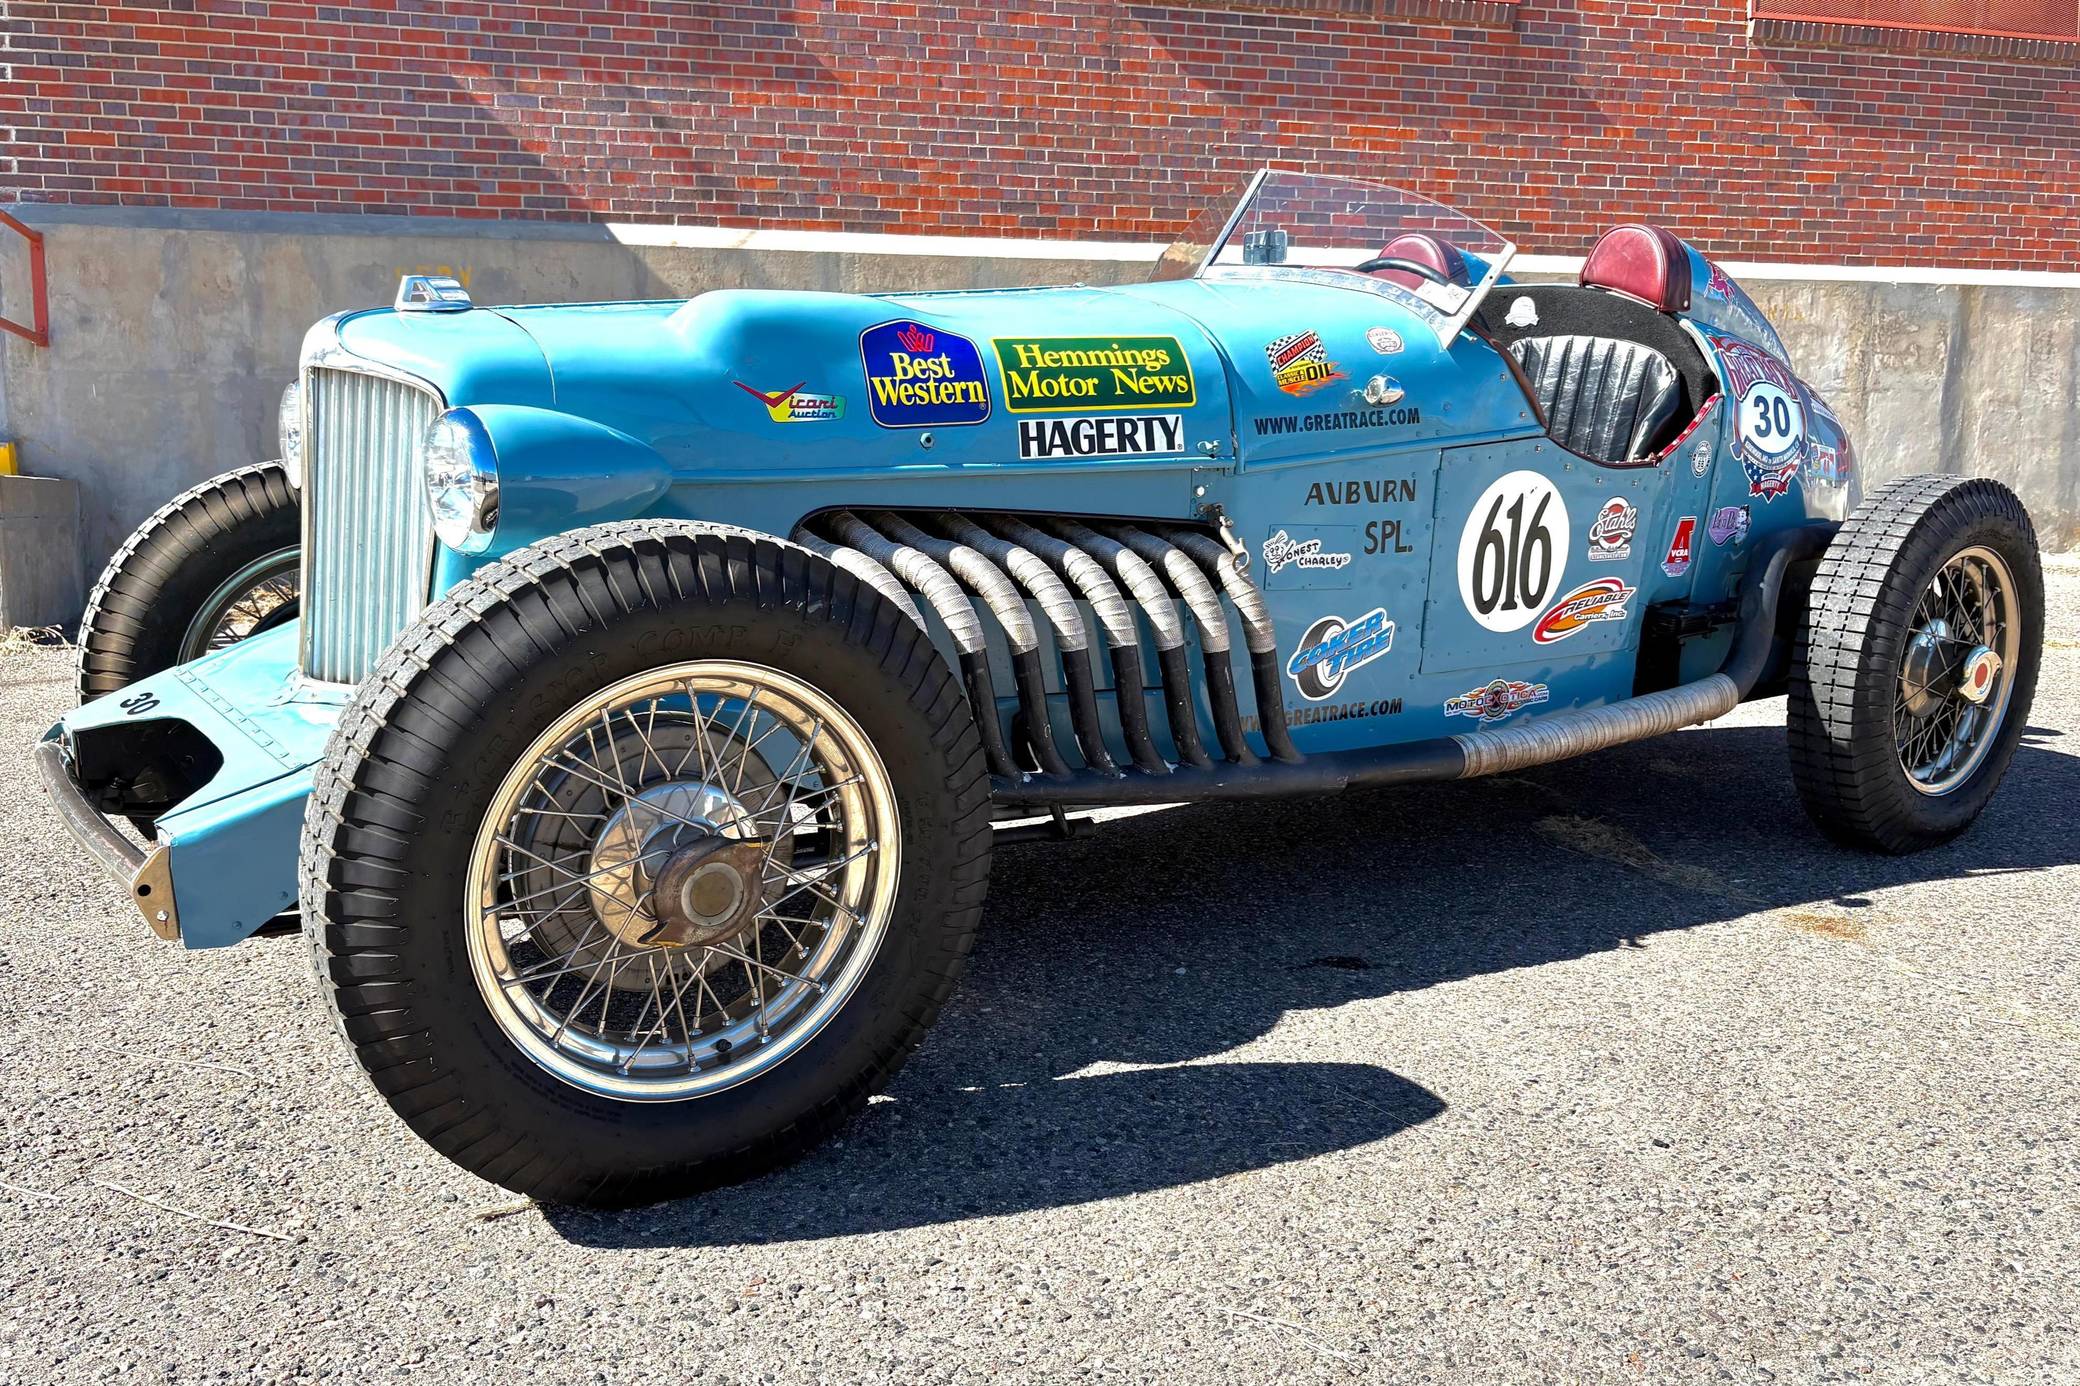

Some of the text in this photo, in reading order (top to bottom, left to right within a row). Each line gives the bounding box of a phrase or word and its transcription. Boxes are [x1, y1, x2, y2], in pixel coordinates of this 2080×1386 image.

[1016, 343, 1171, 373] Hemmings
[1276, 334, 1316, 366] CHAMPION
[888, 352, 956, 381] Best
[1306, 363, 1334, 380] OIL
[870, 375, 984, 408] Western
[1008, 368, 1190, 400] Motor News
[787, 407, 839, 420] Auction
[1254, 408, 1420, 436] WWW.GREATRACE.COM
[1753, 395, 1791, 438] 30
[1020, 417, 1179, 457] HAGERTY
[1304, 478, 1417, 506] AUBURN
[1364, 520, 1414, 555] SPL.
[1472, 490, 1552, 615] 616
[1298, 554, 1344, 568] CHARLEY
[1564, 592, 1628, 615] RELIABLE
[1289, 610, 1385, 675] COKER
[1326, 625, 1394, 679] TIRE
[119, 692, 160, 712] 30
